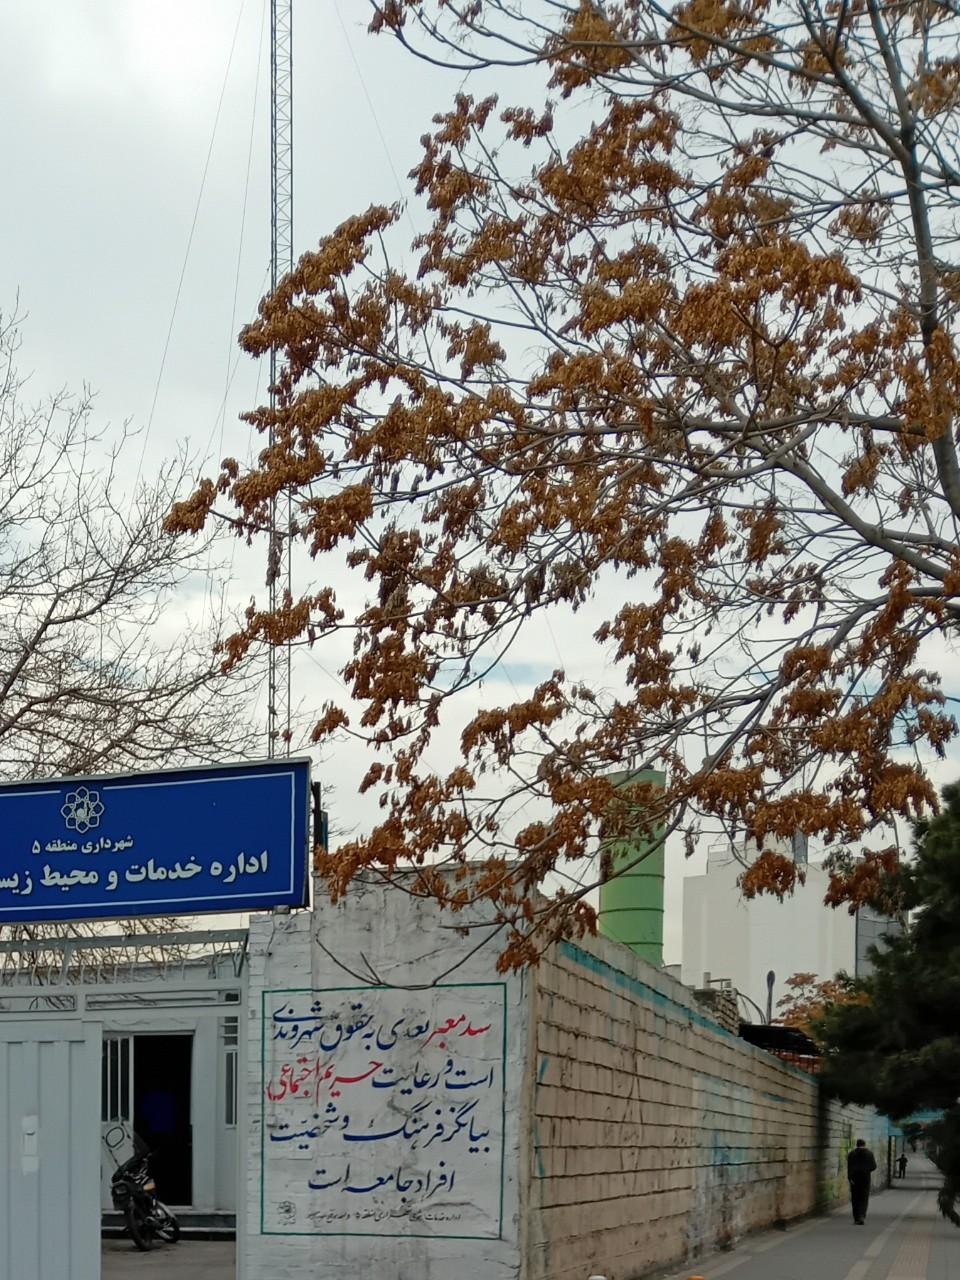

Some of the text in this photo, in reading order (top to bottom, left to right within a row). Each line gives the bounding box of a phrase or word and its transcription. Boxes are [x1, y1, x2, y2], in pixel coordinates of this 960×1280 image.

[32, 835, 134, 856] شهرداری منطقه ۵
[40, 865, 99, 892] محیط
[106, 871, 118, 891] و
[125, 856, 202, 883] خدمات
[210, 851, 269, 883] اداره
[420, 1014, 466, 1049] معبر
[458, 1021, 492, 1036] سد
[371, 1061, 440, 1095] رعایت
[444, 1066, 494, 1089] است
[343, 1099, 443, 1150] فرهنگ
[441, 1099, 490, 1153] بیانگر
[308, 1161, 456, 1204] افراد جامعه است
